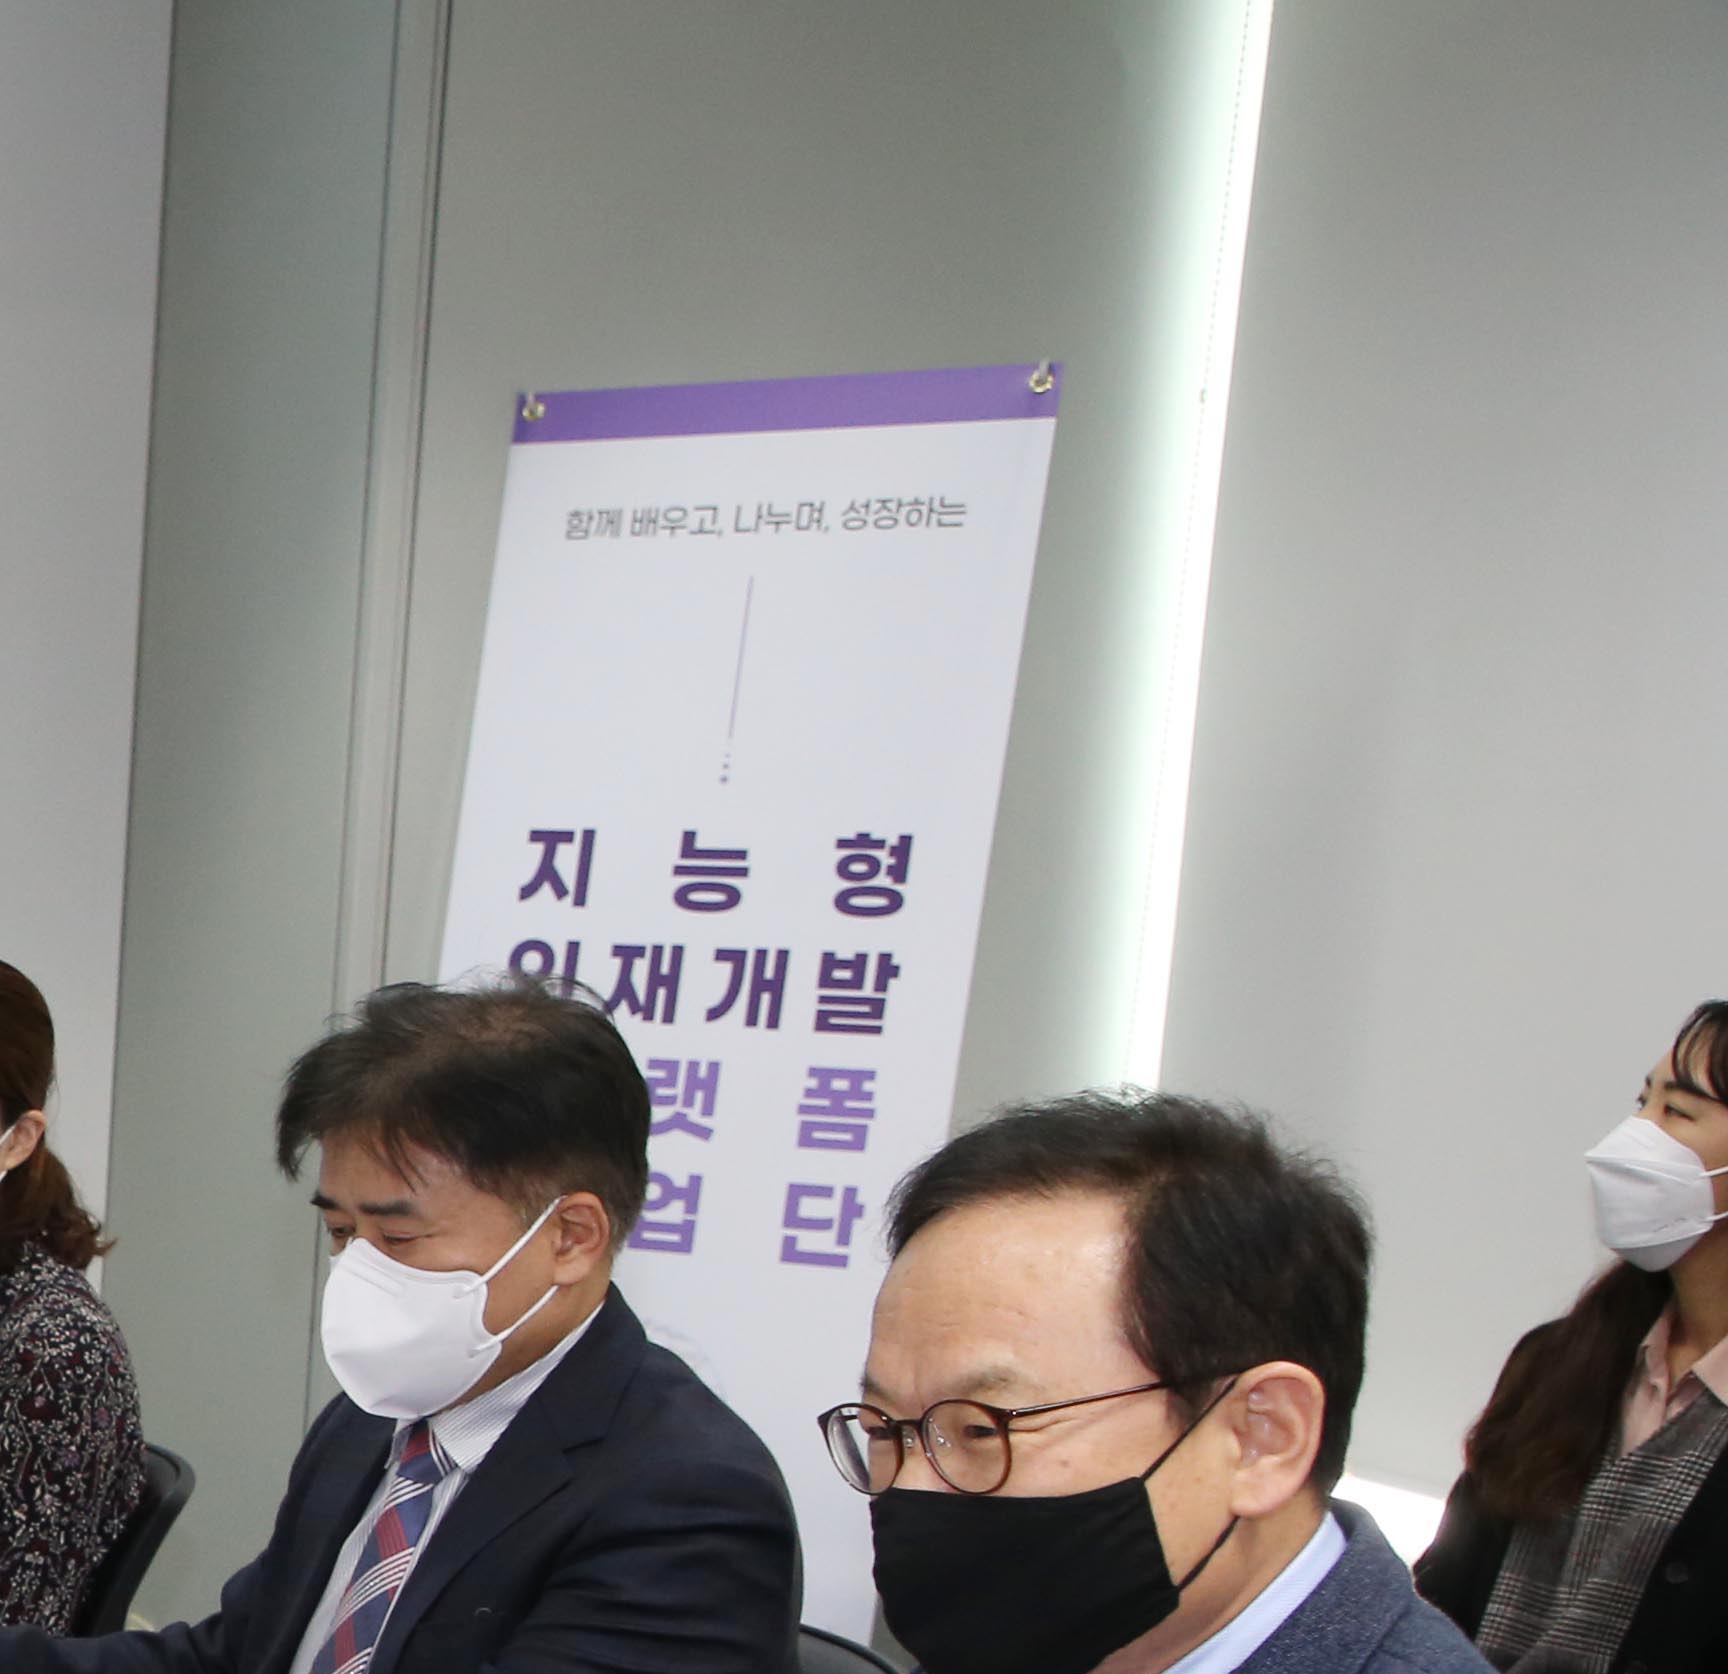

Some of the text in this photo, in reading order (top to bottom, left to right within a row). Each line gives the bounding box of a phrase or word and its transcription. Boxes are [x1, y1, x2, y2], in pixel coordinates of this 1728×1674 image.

[564, 496, 966, 540] 함께 배우고, 나누며, 성장하는
[646, 1059, 877, 1151] 랫폼
[628, 1171, 866, 1269] 업단
